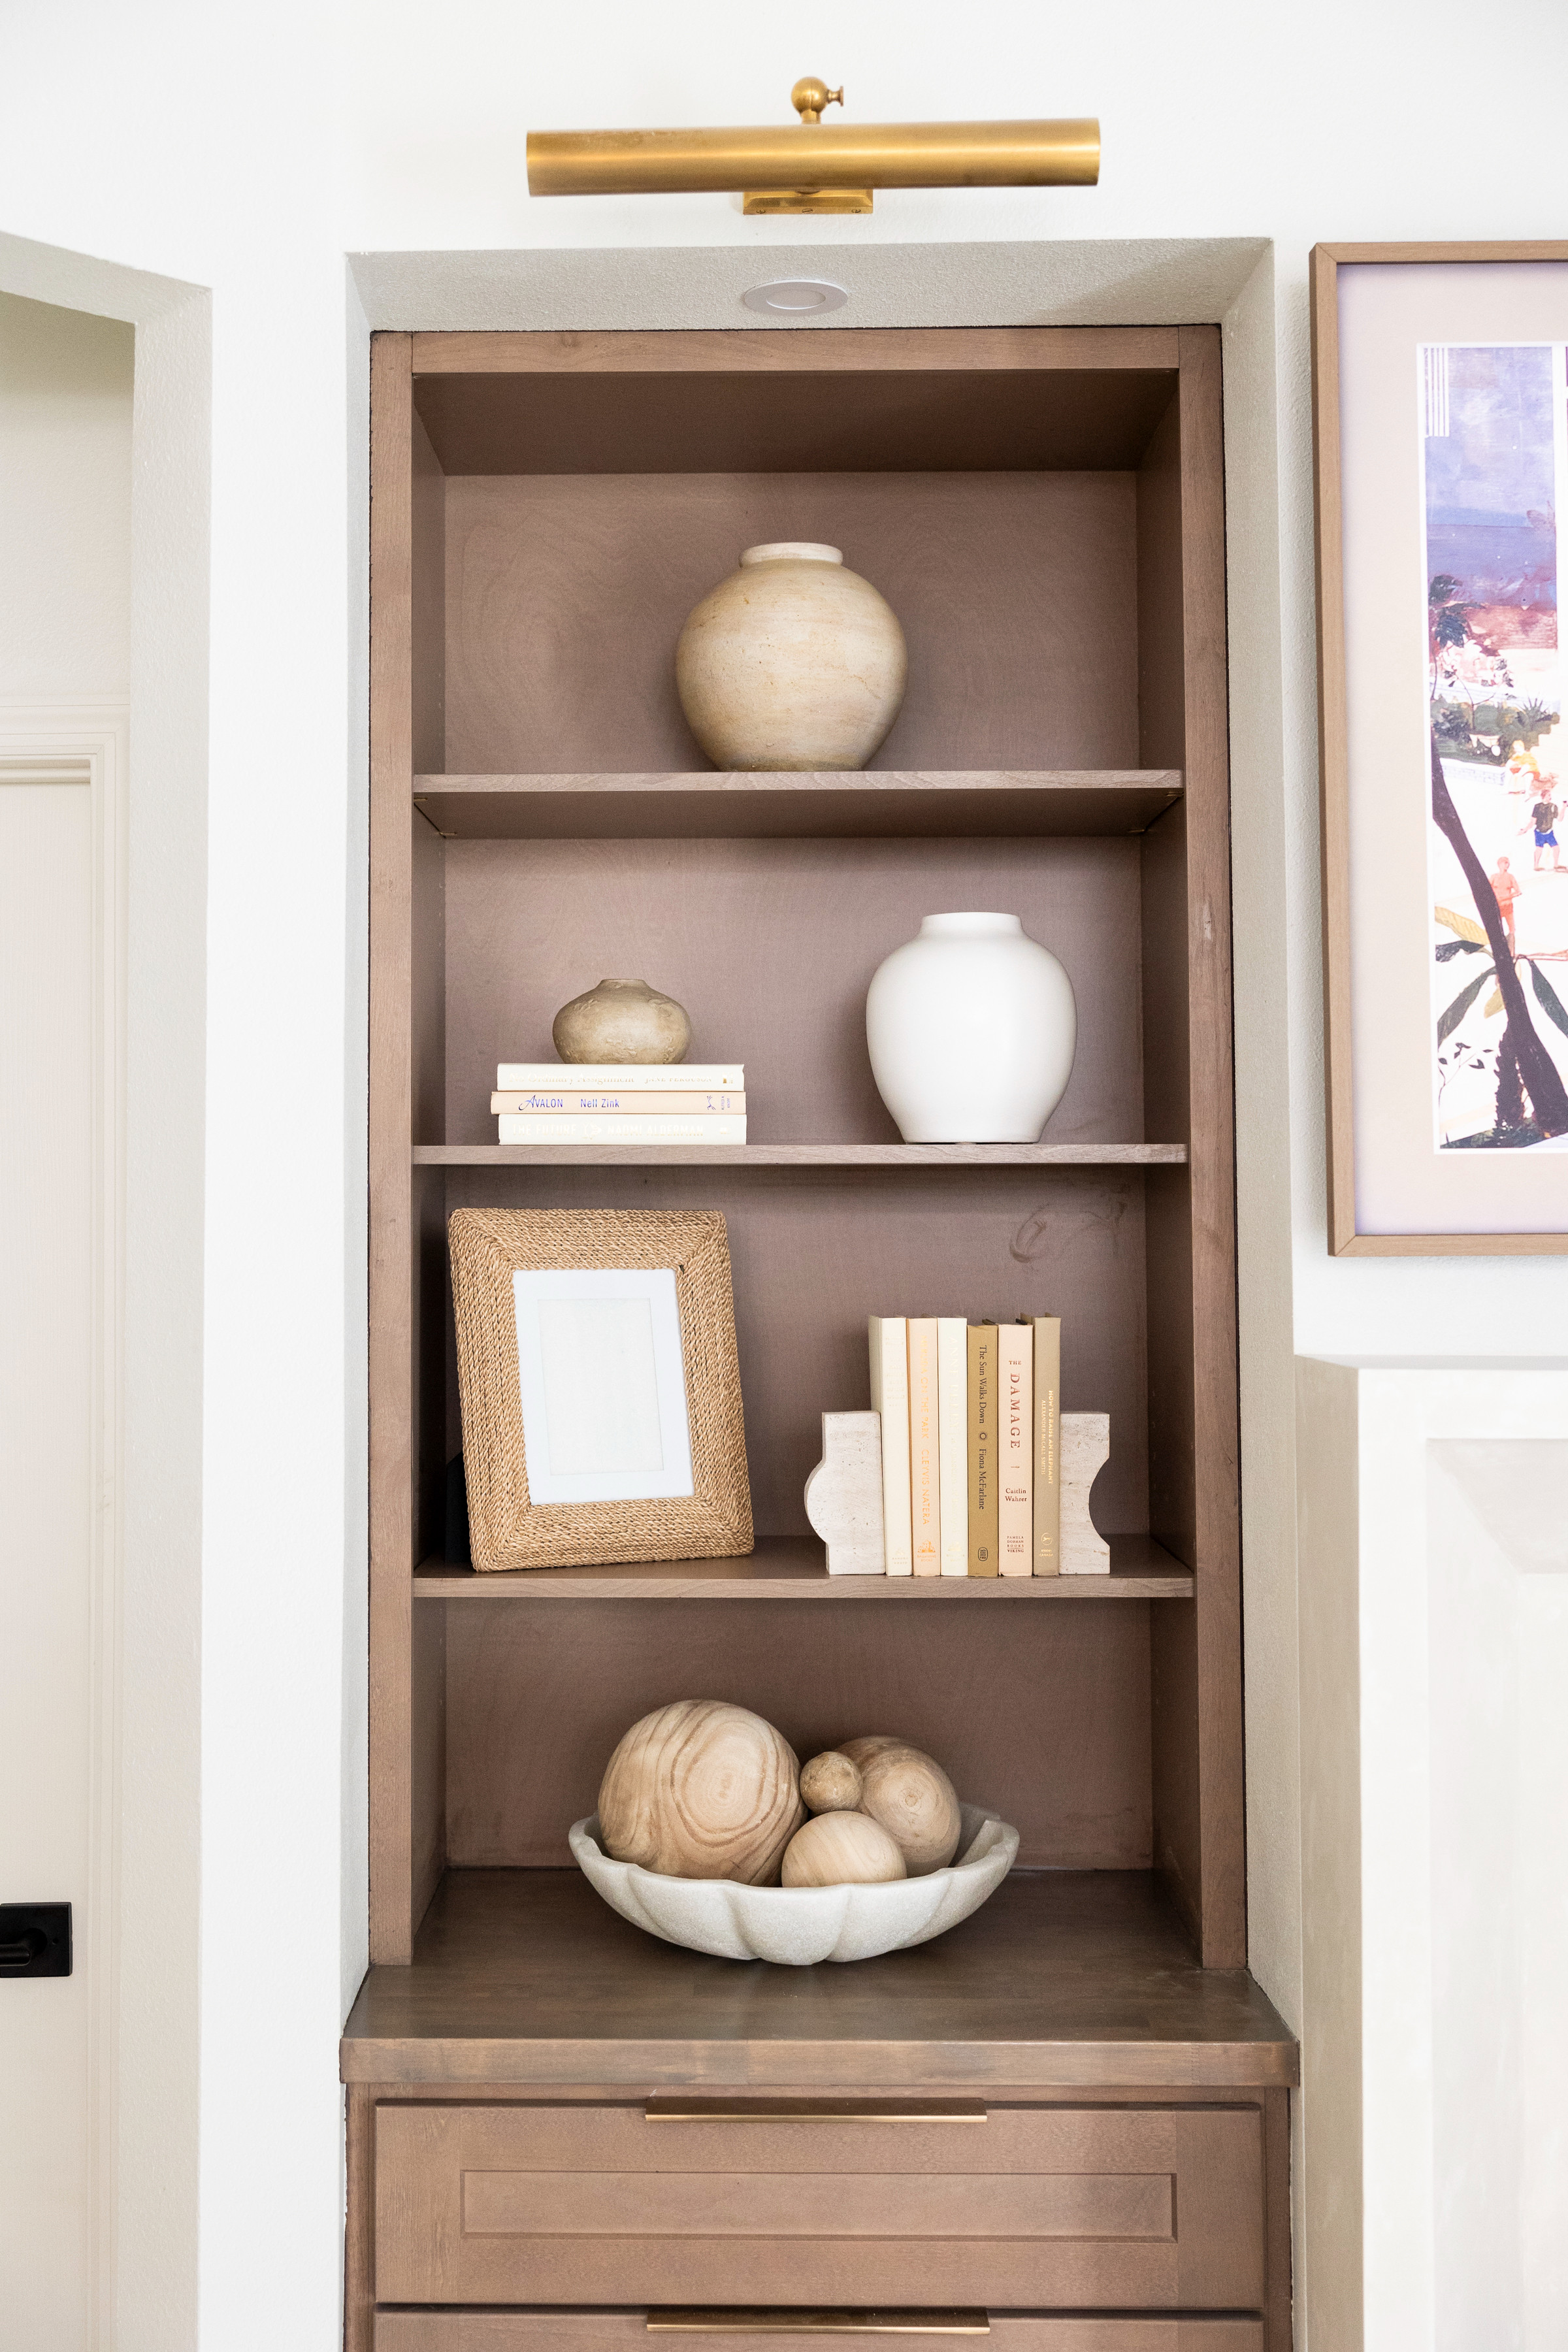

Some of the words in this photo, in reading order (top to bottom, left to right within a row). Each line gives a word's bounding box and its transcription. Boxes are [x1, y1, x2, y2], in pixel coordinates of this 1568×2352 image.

[527, 1073, 573, 1085] Ordinary
[518, 1094, 564, 1111] AVALON
[580, 1099, 598, 1108] Nell
[601, 1098, 619, 1108] Zink
[512, 1124, 531, 1136] THE
[536, 1124, 577, 1136] FUTURE
[979, 1345, 987, 1360] The
[979, 1362, 987, 1376] Sun
[979, 1377, 987, 1399] Walks
[979, 1402, 987, 1424] Down
[1009, 1373, 1021, 1449] DAMAGE
[1048, 1408, 1054, 1417] TO
[1048, 1439, 1054, 1450] AN
[922, 1449, 930, 1485] CLEYVIS
[979, 1448, 987, 1469] Fiona
[979, 1471, 987, 1510] McFarlane
[922, 1488, 930, 1525] NATERA
